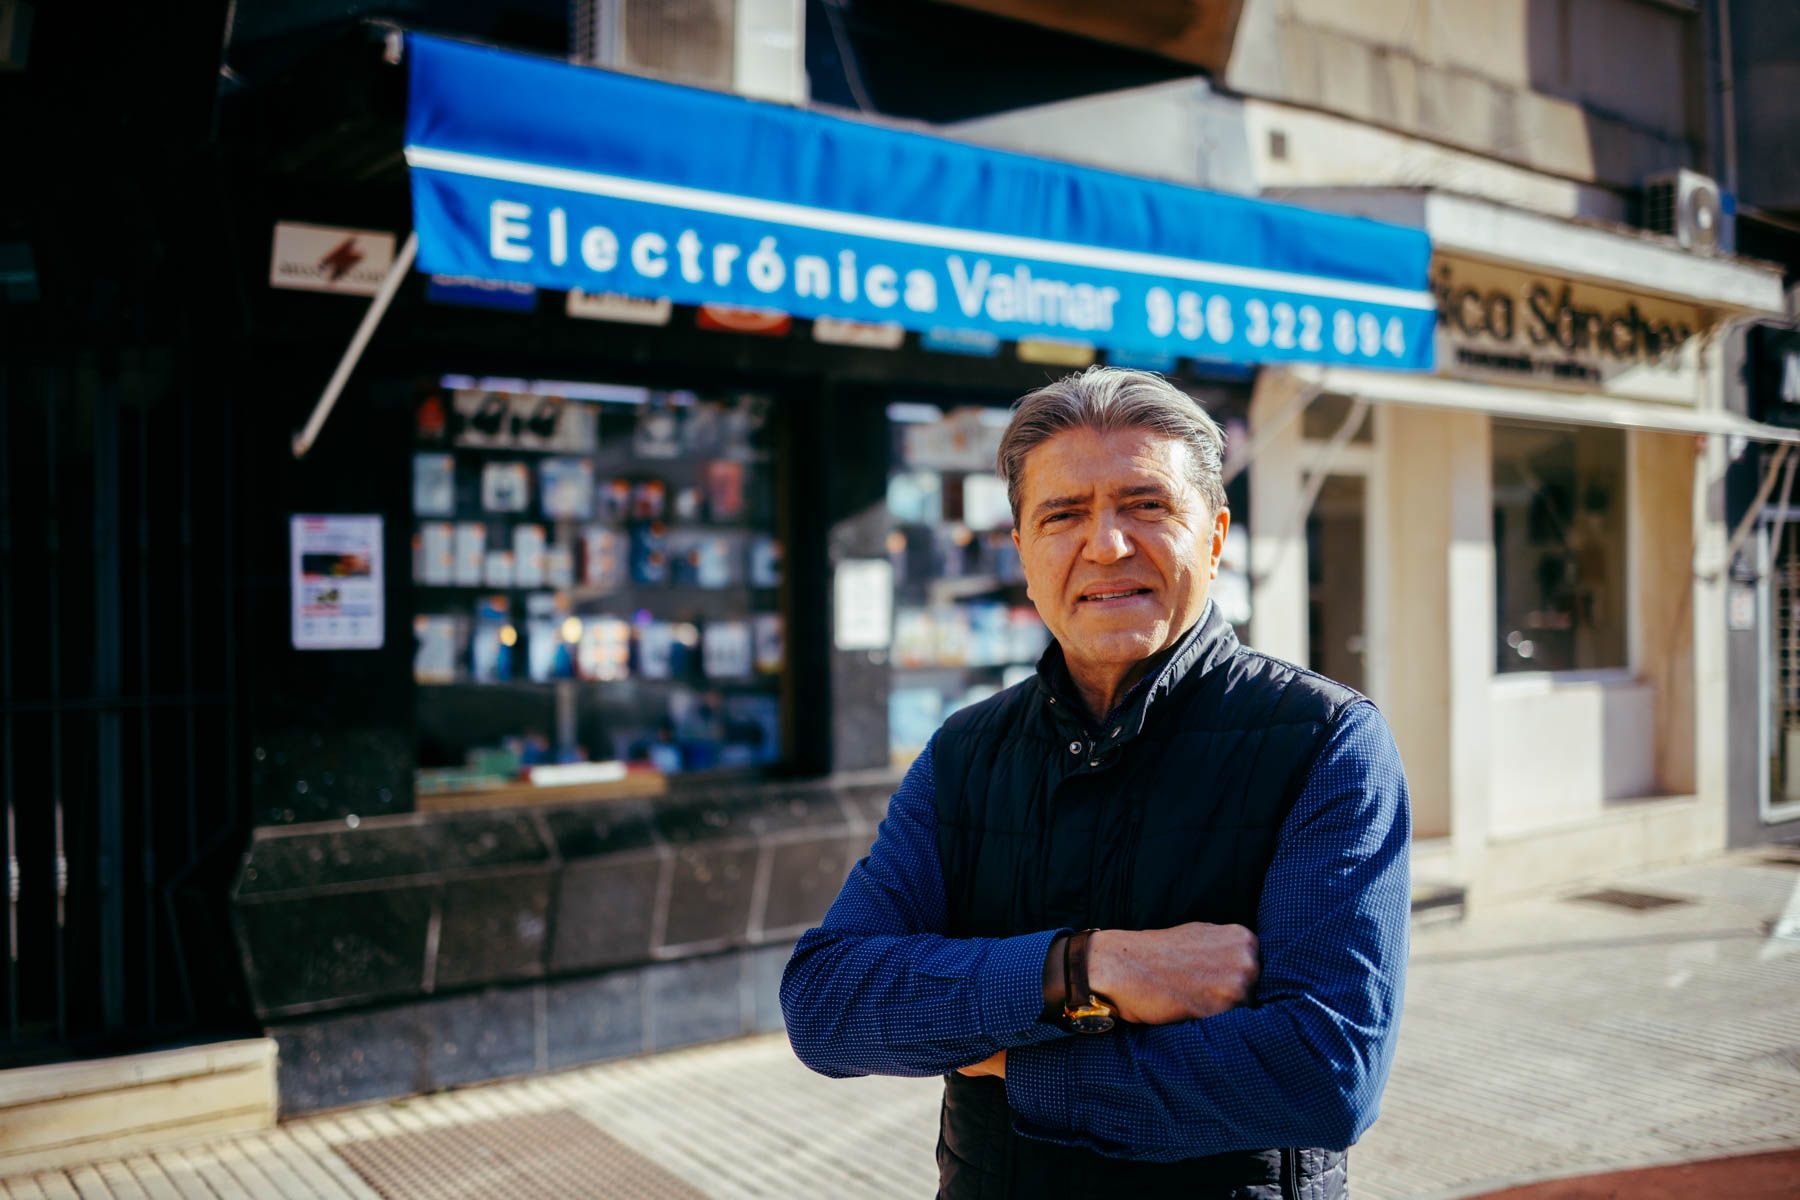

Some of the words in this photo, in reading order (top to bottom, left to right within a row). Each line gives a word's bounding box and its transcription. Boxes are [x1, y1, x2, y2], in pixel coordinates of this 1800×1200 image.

[489, 199, 938, 313] Electrónica
[946, 254, 1120, 331] Valmar
[1145, 286, 1234, 345] 956
[1244, 298, 1323, 352] 322
